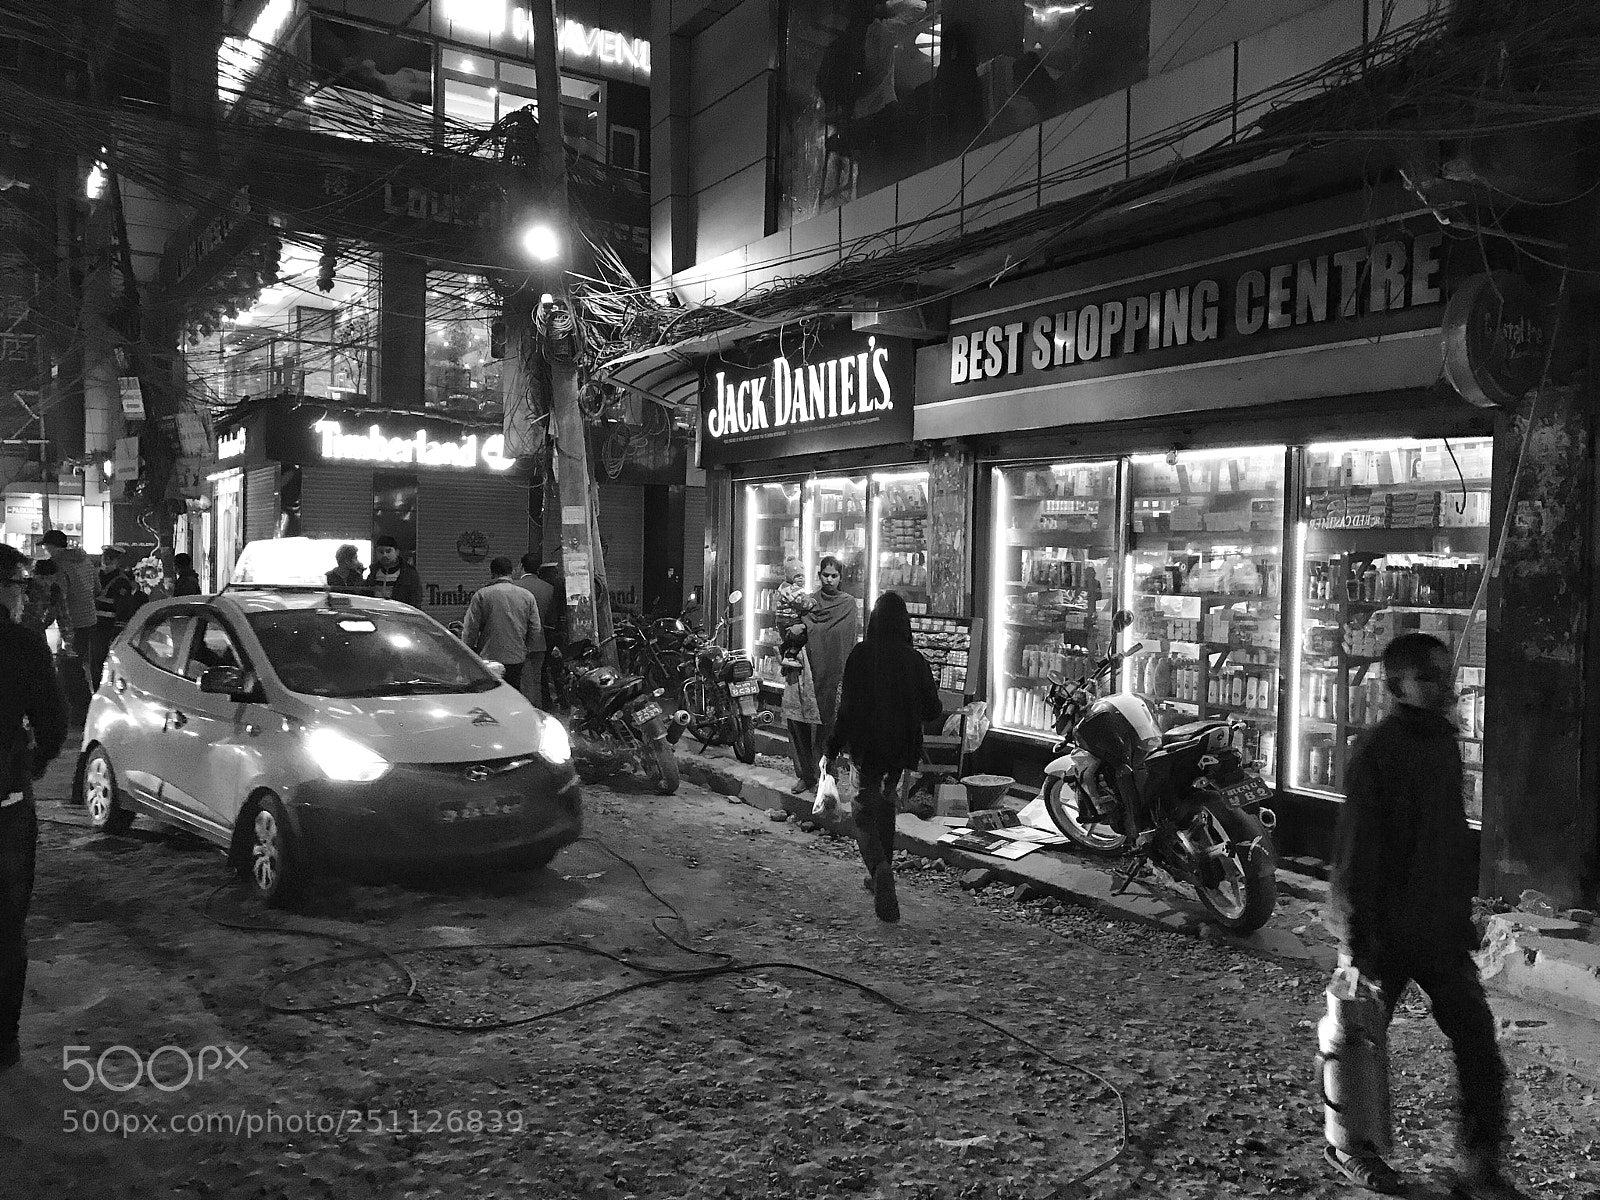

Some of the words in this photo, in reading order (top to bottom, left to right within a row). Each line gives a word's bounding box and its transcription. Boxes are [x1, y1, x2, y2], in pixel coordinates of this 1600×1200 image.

[951, 321, 1023, 384] BEST
[1031, 279, 1220, 370] SHOPPING
[1235, 231, 1443, 335] CENTRE
[708, 371, 769, 438] JACK
[314, 420, 476, 466] Timberland
